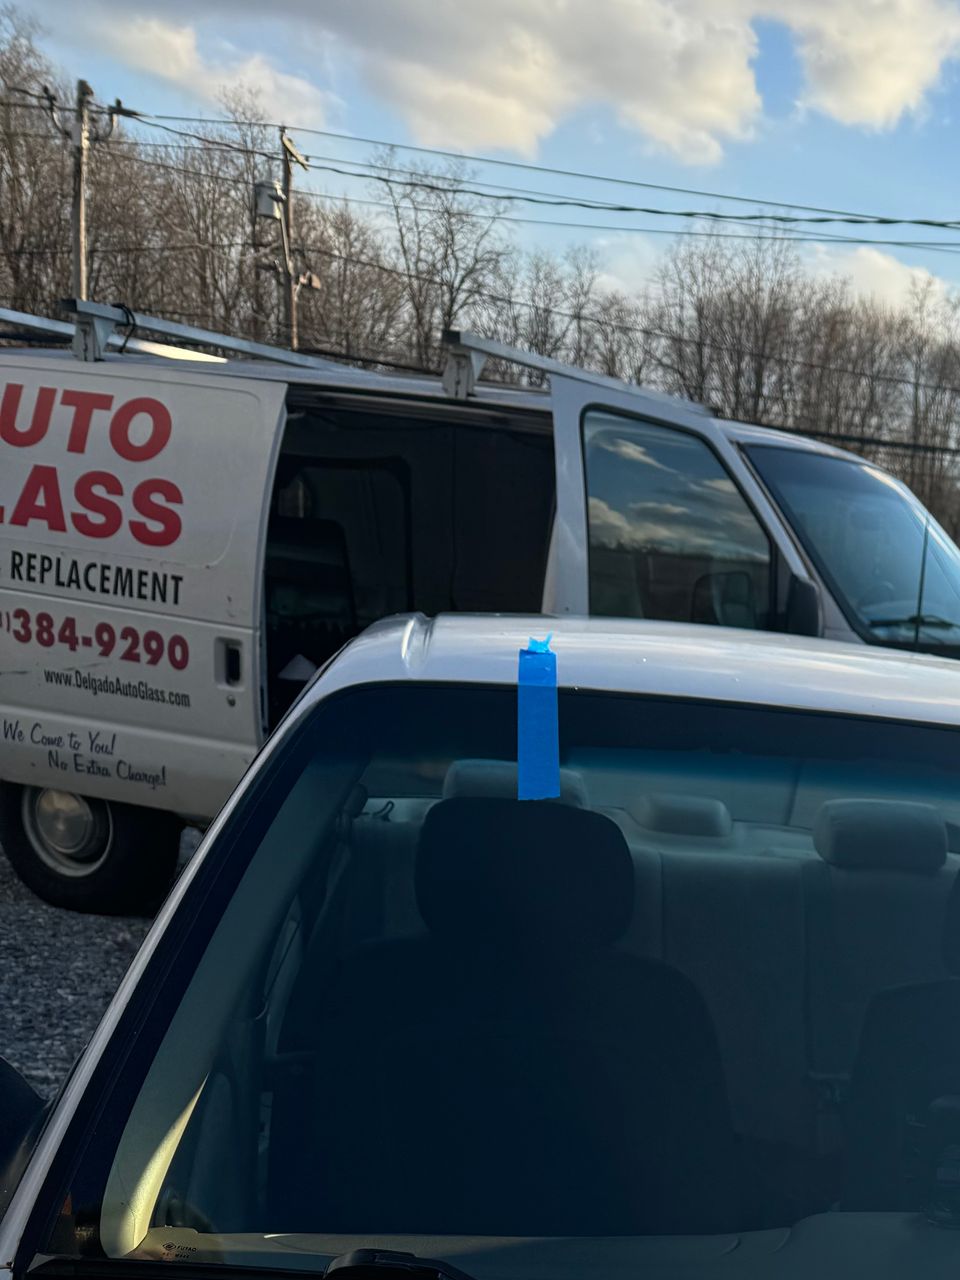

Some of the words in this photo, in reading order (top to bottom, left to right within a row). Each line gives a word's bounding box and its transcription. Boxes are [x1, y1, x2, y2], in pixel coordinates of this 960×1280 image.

[0, 464, 183, 547] ASS
[11, 550, 183, 605] REPLACEMENT
[0, 608, 189, 671] )384-9290
[44, 669, 191, 708] www.DelgadoAutoGlass.com
[3, 720, 24, 741] We
[30, 722, 65, 748] Come
[67, 731, 82, 751] to
[88, 731, 116, 755] You!
[48, 751, 68, 771] No
[73, 753, 111, 777] Extra
[116, 759, 167, 789] Charge!
